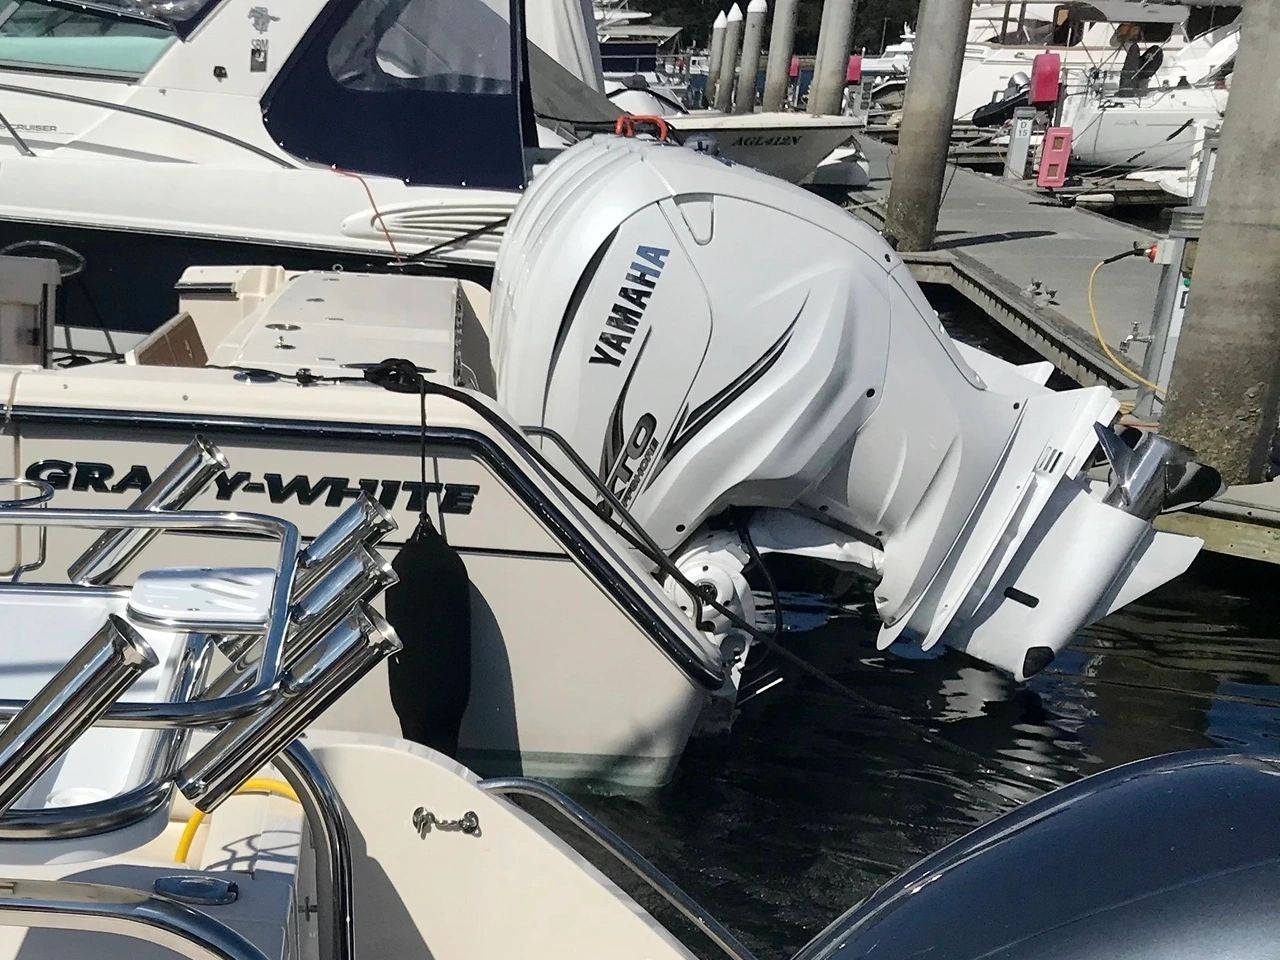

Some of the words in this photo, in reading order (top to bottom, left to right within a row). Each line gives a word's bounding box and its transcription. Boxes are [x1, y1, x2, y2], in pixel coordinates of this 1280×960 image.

[9, 123, 58, 132] CRUISER
[588, 245, 670, 368] YAMAHA
[25, 459, 480, 515] GRAY-WHITE
[605, 412, 657, 502] TO
